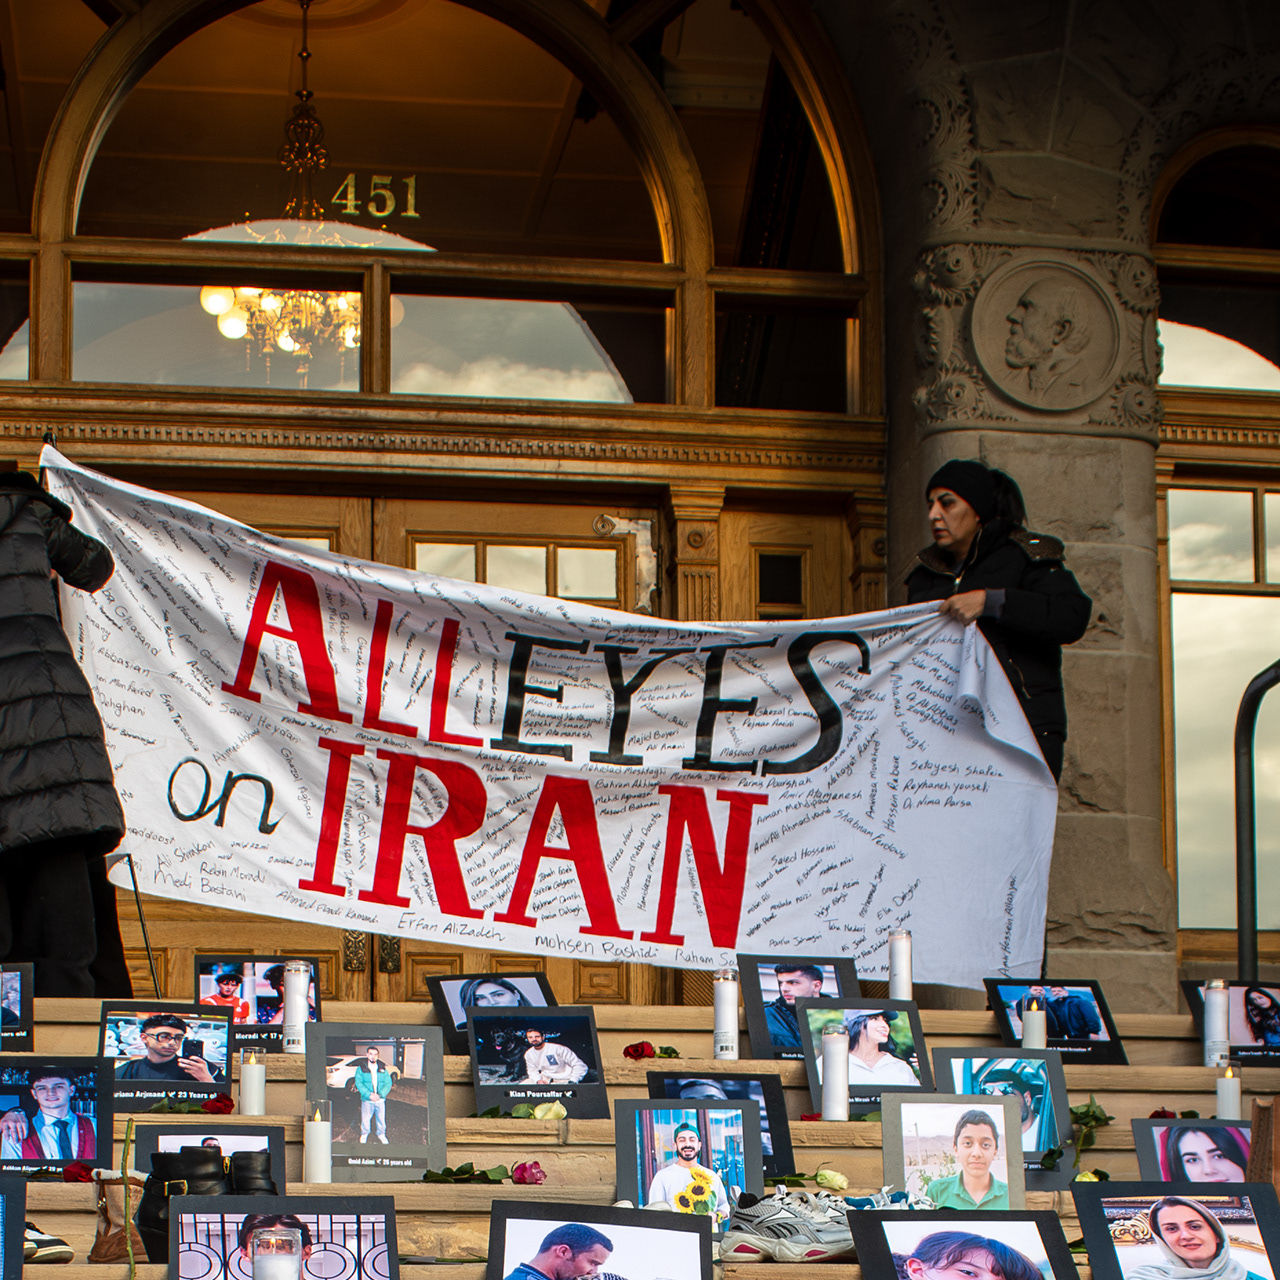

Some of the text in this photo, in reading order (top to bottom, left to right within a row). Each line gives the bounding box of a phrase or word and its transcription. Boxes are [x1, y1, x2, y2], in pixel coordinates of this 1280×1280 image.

[331, 172, 420, 218] 451
[221, 560, 483, 746] ALL
[490, 630, 870, 777] EYES
[167, 736, 769, 949] on IRAN
[602, 941, 659, 959] Rashidi
